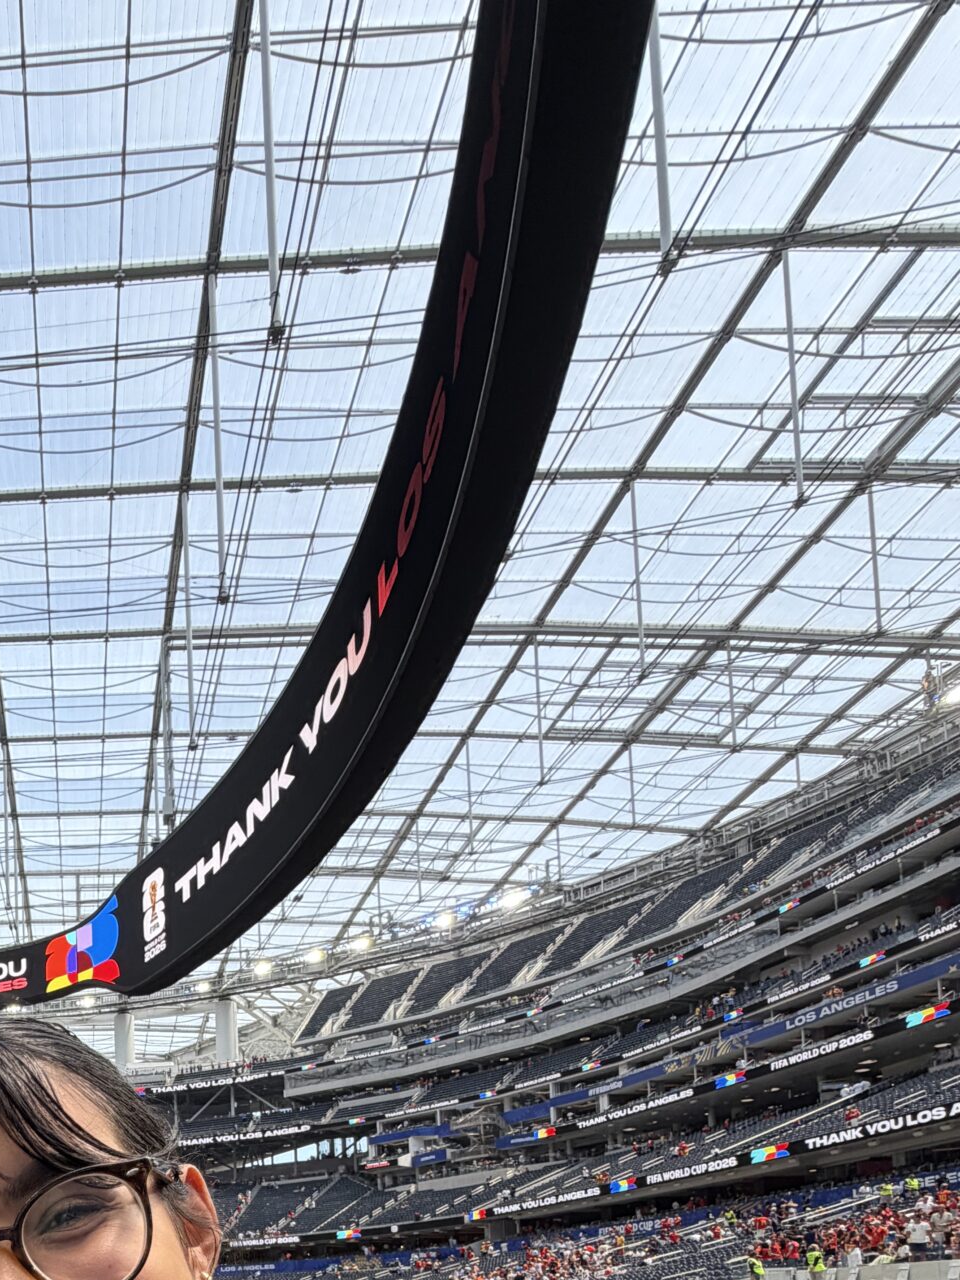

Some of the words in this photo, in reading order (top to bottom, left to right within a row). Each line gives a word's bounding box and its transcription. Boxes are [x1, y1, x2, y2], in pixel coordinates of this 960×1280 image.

[175, 744, 296, 904] THANK
[299, 597, 372, 755] YOU
[918, 920, 958, 942] THANK
[785, 1010, 817, 1030] LOS
[818, 979, 899, 1019] ANGELES
[770, 1060, 789, 1071] FIFA
[788, 1048, 819, 1066] WORLD
[819, 1042, 839, 1055] CUP
[838, 1030, 874, 1050] 2026
[150, 1083, 188, 1094] THANK
[189, 1080, 211, 1089] YOU
[212, 1077, 234, 1086] LOS
[576, 1115, 607, 1129] THANK
[607, 1108, 627, 1120] YOU
[627, 1102, 647, 1115] LOS
[647, 1088, 694, 1109] ANGELES
[178, 1137, 214, 1147] THANK
[215, 1133, 239, 1143] YOU
[239, 1131, 262, 1140] LOS
[804, 1126, 864, 1150] THANK
[866, 1116, 904, 1135] YOU
[906, 1106, 946, 1127] LOS
[646, 1174, 664, 1185] FIFA
[663, 1168, 691, 1181] WORLD
[690, 1162, 708, 1175] CUP
[707, 1156, 738, 1172] 2026
[493, 1203, 521, 1215] THANK
[522, 1199, 540, 1210] YOU
[540, 1195, 558, 1205] LOS
[558, 1187, 601, 1203] ANGELES
[243, 1238, 264, 1247] WORLD
[264, 1236, 277, 1244] CUP
[220, 1264, 236, 1272] LOS
